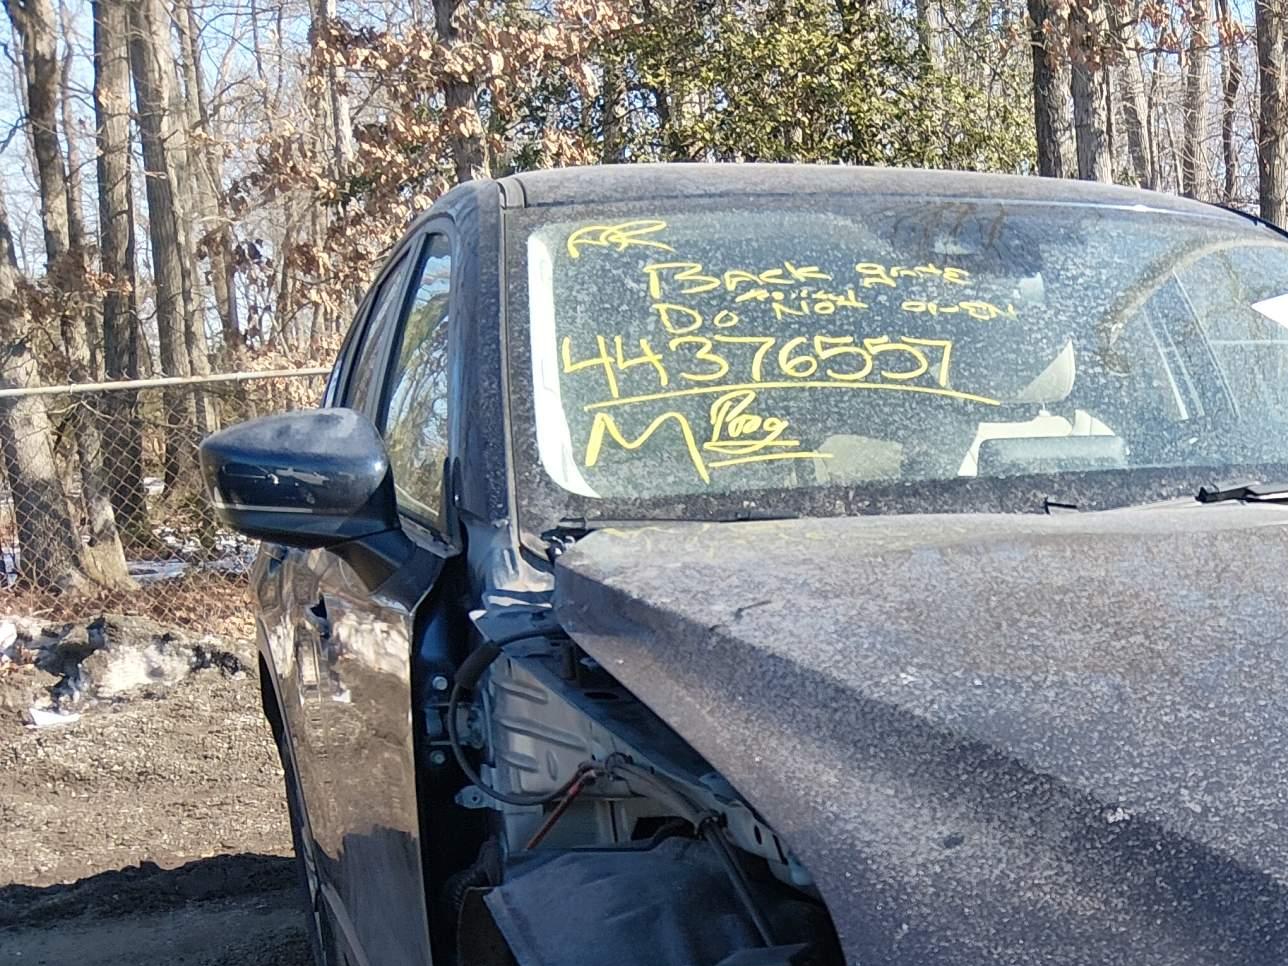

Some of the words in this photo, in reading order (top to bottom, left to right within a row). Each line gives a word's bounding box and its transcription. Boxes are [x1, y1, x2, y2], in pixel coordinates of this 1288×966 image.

[651, 303, 739, 335] Do
[561, 335, 953, 398] 44376557
[584, 412, 710, 484] M
